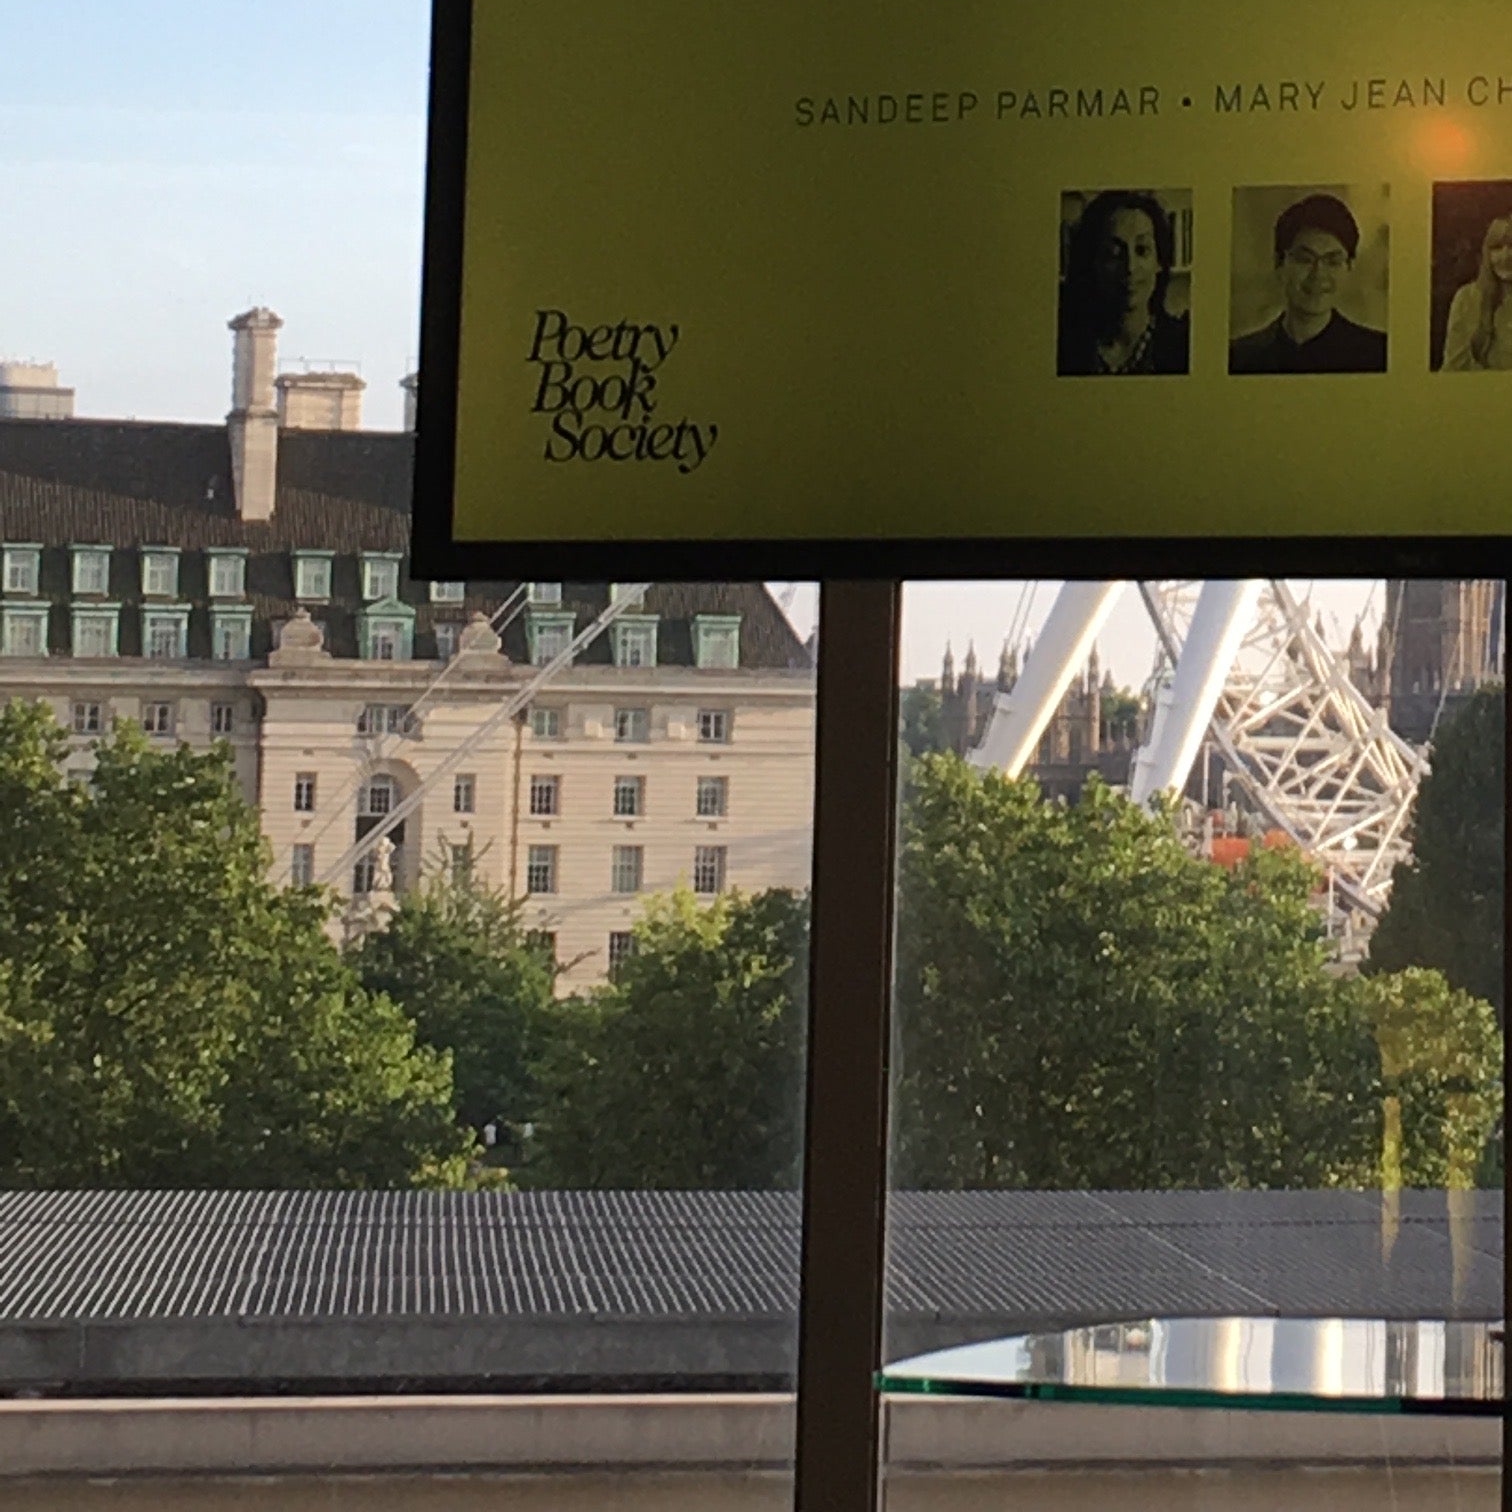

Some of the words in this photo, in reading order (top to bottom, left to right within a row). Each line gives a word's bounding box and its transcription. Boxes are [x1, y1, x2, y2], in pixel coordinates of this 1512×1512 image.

[795, 93, 978, 127] SANDEEP
[997, 87, 1159, 120] PARMAR
[1215, 81, 1325, 113] MARY
[1341, 78, 1446, 112] JEAN
[525, 308, 680, 374] Poetry
[530, 356, 658, 421] Book
[543, 407, 718, 474] Society
